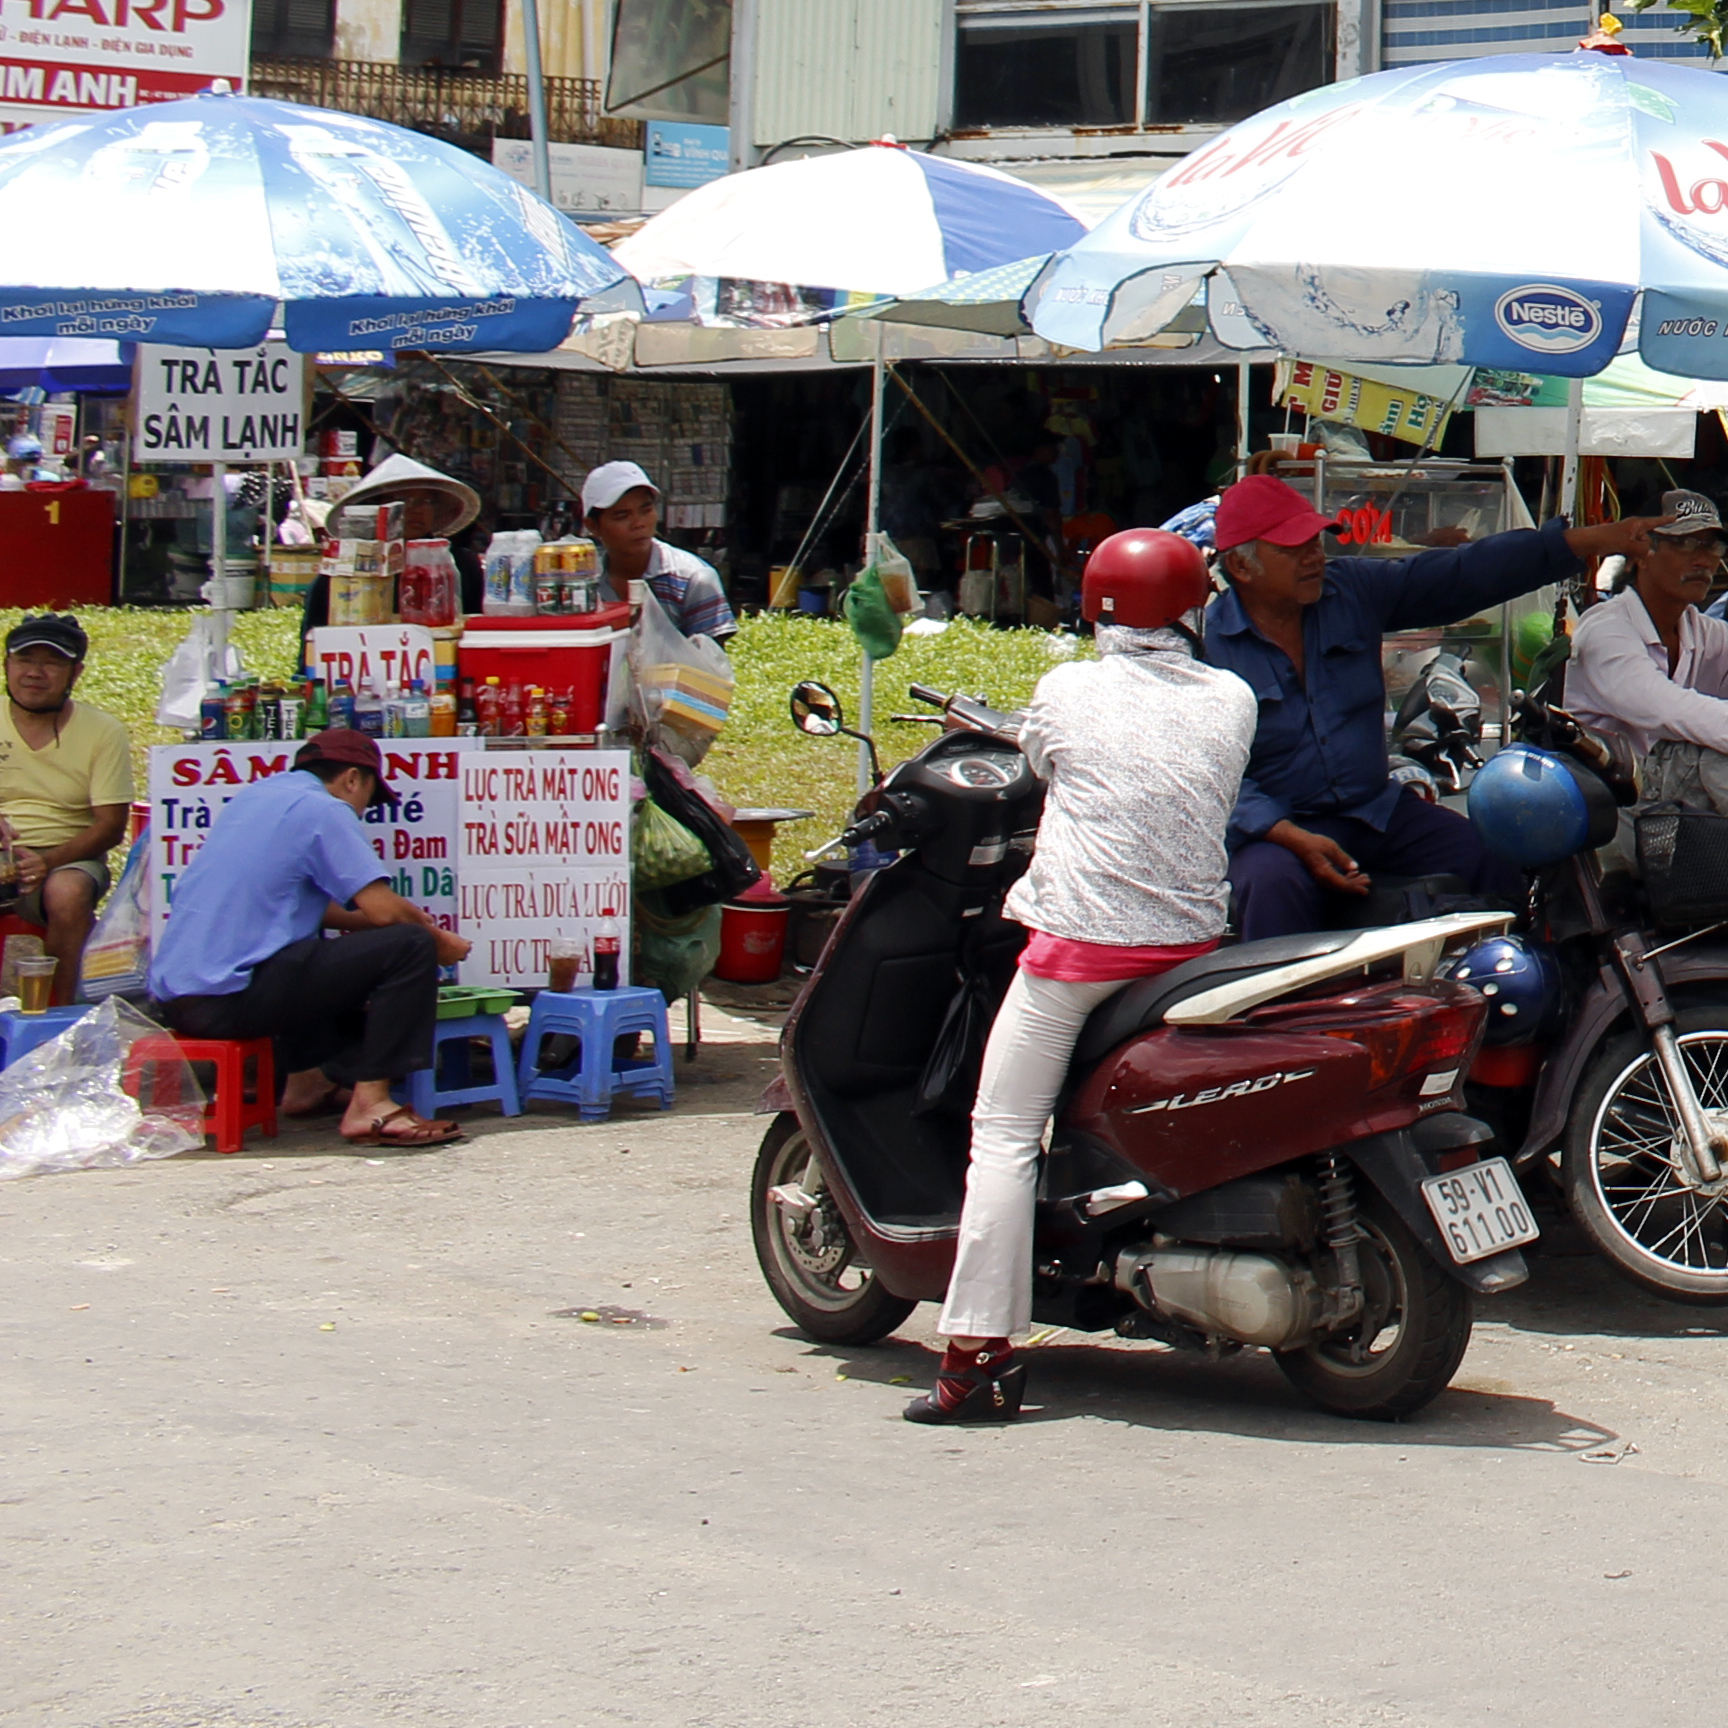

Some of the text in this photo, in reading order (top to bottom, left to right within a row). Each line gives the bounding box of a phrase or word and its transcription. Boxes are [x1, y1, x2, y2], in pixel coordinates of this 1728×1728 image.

[19, 31, 50, 47] ĐIỆN
[54, 35, 89, 51] LẠNH
[101, 37, 132, 55] ĐIỆN
[135, 41, 156, 56] GIA
[159, 44, 194, 60] DỤNG
[48, 70, 138, 107] ANH
[100, 316, 157, 334] ngày
[427, 323, 478, 344] ngày
[1657, 316, 1717, 339] NƯỚC
[161, 348, 289, 395] TRÀ TẮC
[144, 402, 300, 459] SÂM LẠNH
[43, 500, 60, 525] 1
[320, 631, 433, 696] TRÀ TẮC
[172, 748, 460, 787] SÂM NH
[464, 756, 620, 811] LỤC TRÀ MẬT ONG
[161, 791, 425, 829] Trà afé
[394, 828, 447, 860] Đam
[464, 809, 623, 864] TRÀ SỮA MẬT ONG
[422, 866, 459, 898] Dâ
[461, 883, 498, 930] LỤC
[502, 872, 538, 920] TRÀ
[543, 876, 580, 919] DƯA
[489, 939, 527, 984] LỤC
[1166, 1073, 1283, 1110] LEAD
[1418, 1096, 1452, 1113] HONDA
[1437, 1167, 1505, 1216] 59-V1
[1448, 1201, 1531, 1255] 611.00
